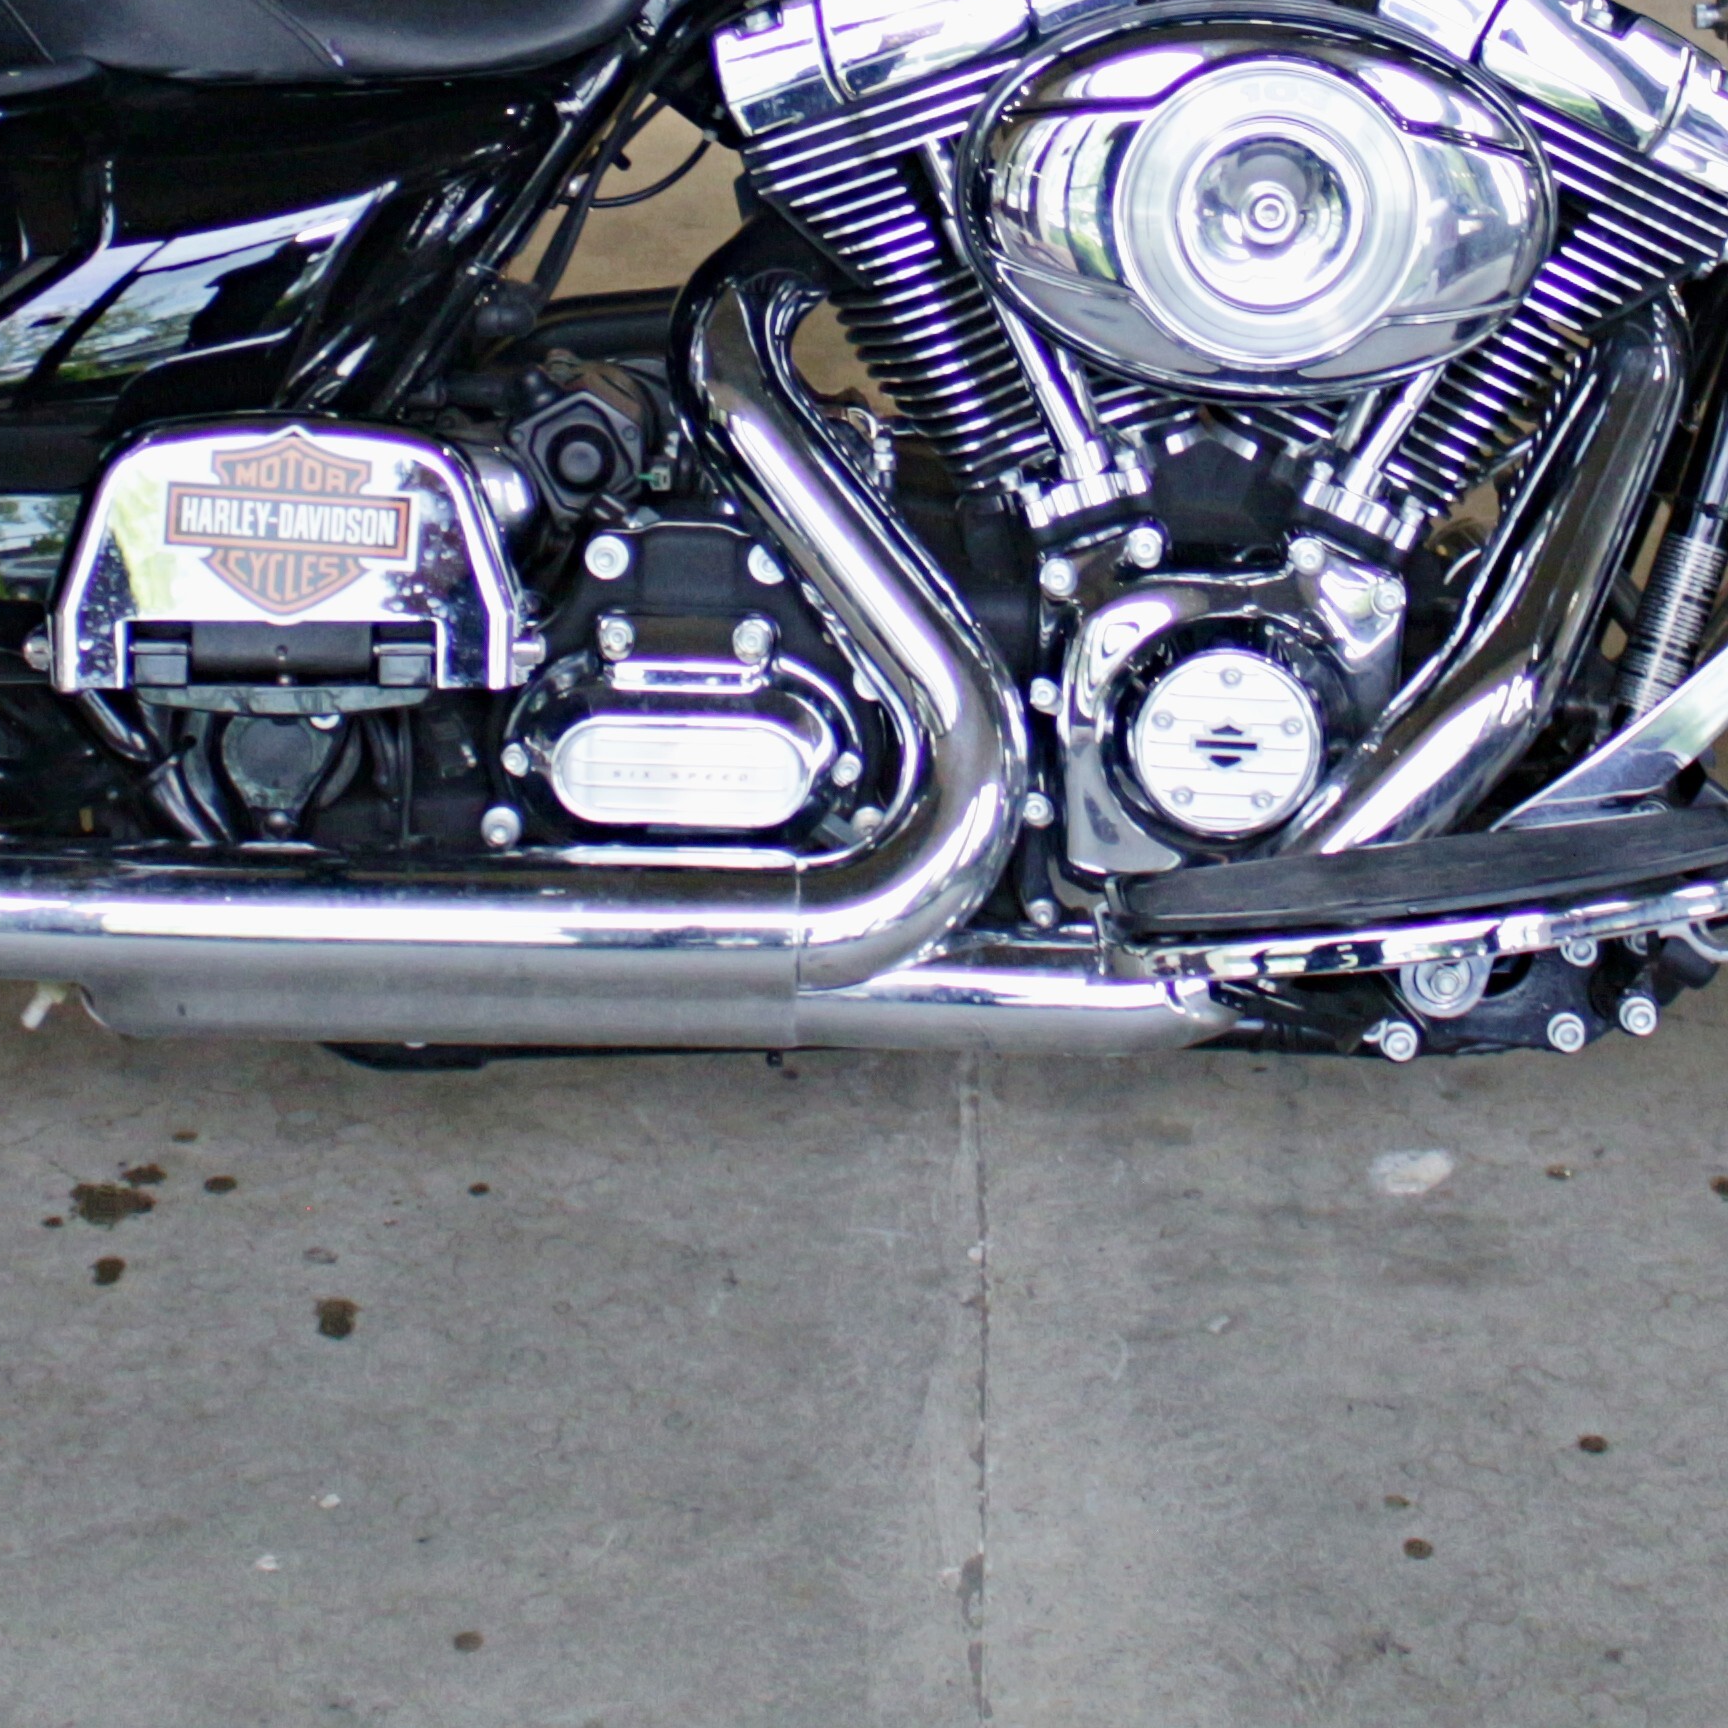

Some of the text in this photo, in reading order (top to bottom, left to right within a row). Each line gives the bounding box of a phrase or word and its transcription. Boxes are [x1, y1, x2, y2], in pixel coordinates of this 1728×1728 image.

[234, 447, 348, 494] MOTOR
[179, 495, 398, 547] HARLEY-DAVIDSON
[226, 550, 342, 602] CYCLES
